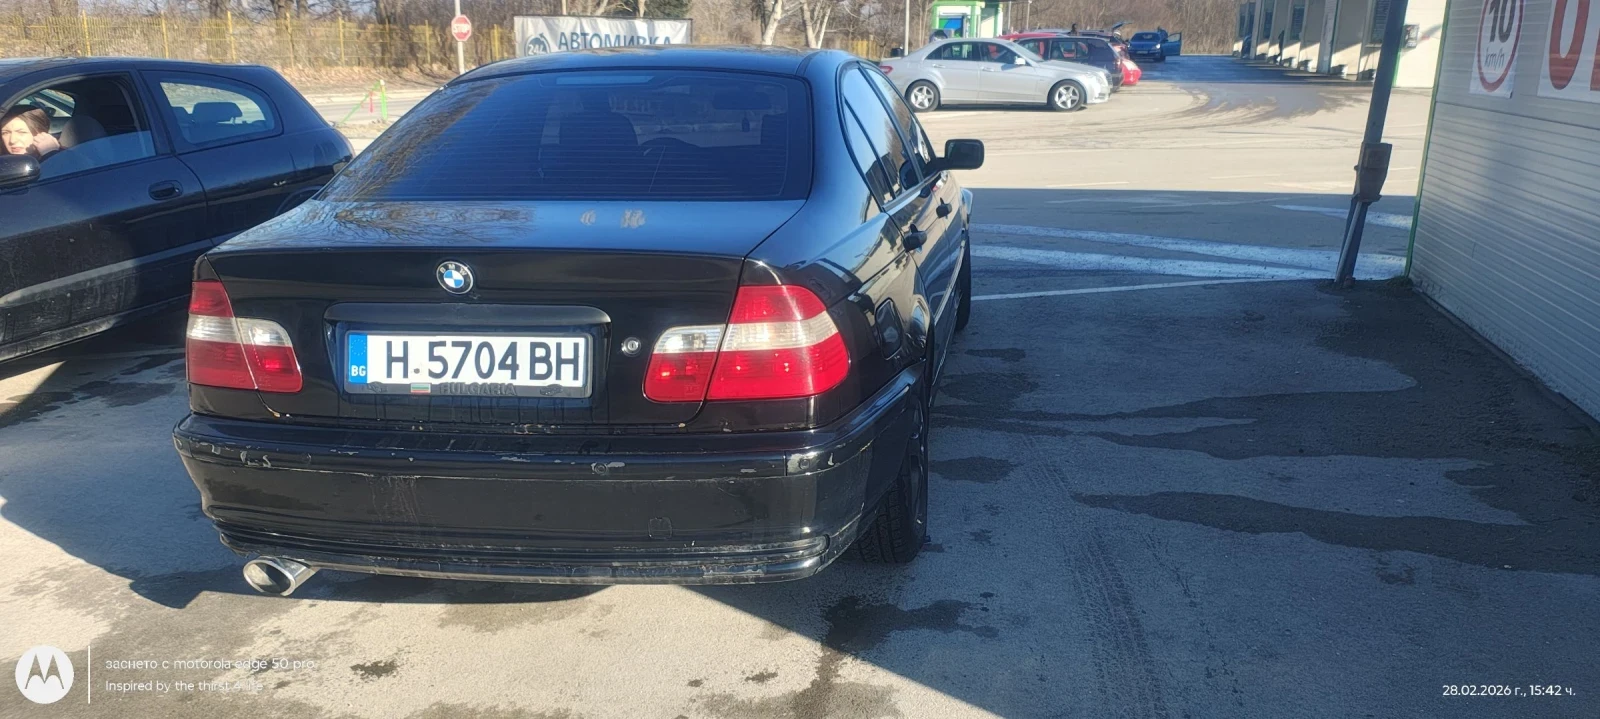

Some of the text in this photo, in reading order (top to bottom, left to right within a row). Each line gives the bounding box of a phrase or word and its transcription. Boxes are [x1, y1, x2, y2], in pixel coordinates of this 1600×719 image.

[1488, 0, 1517, 43] 10
[1484, 47, 1506, 70] km/h
[440, 263, 468, 276] BMW
[428, 340, 520, 380] 5704
[351, 365, 367, 377] BG
[438, 382, 518, 396] BULGARIA
